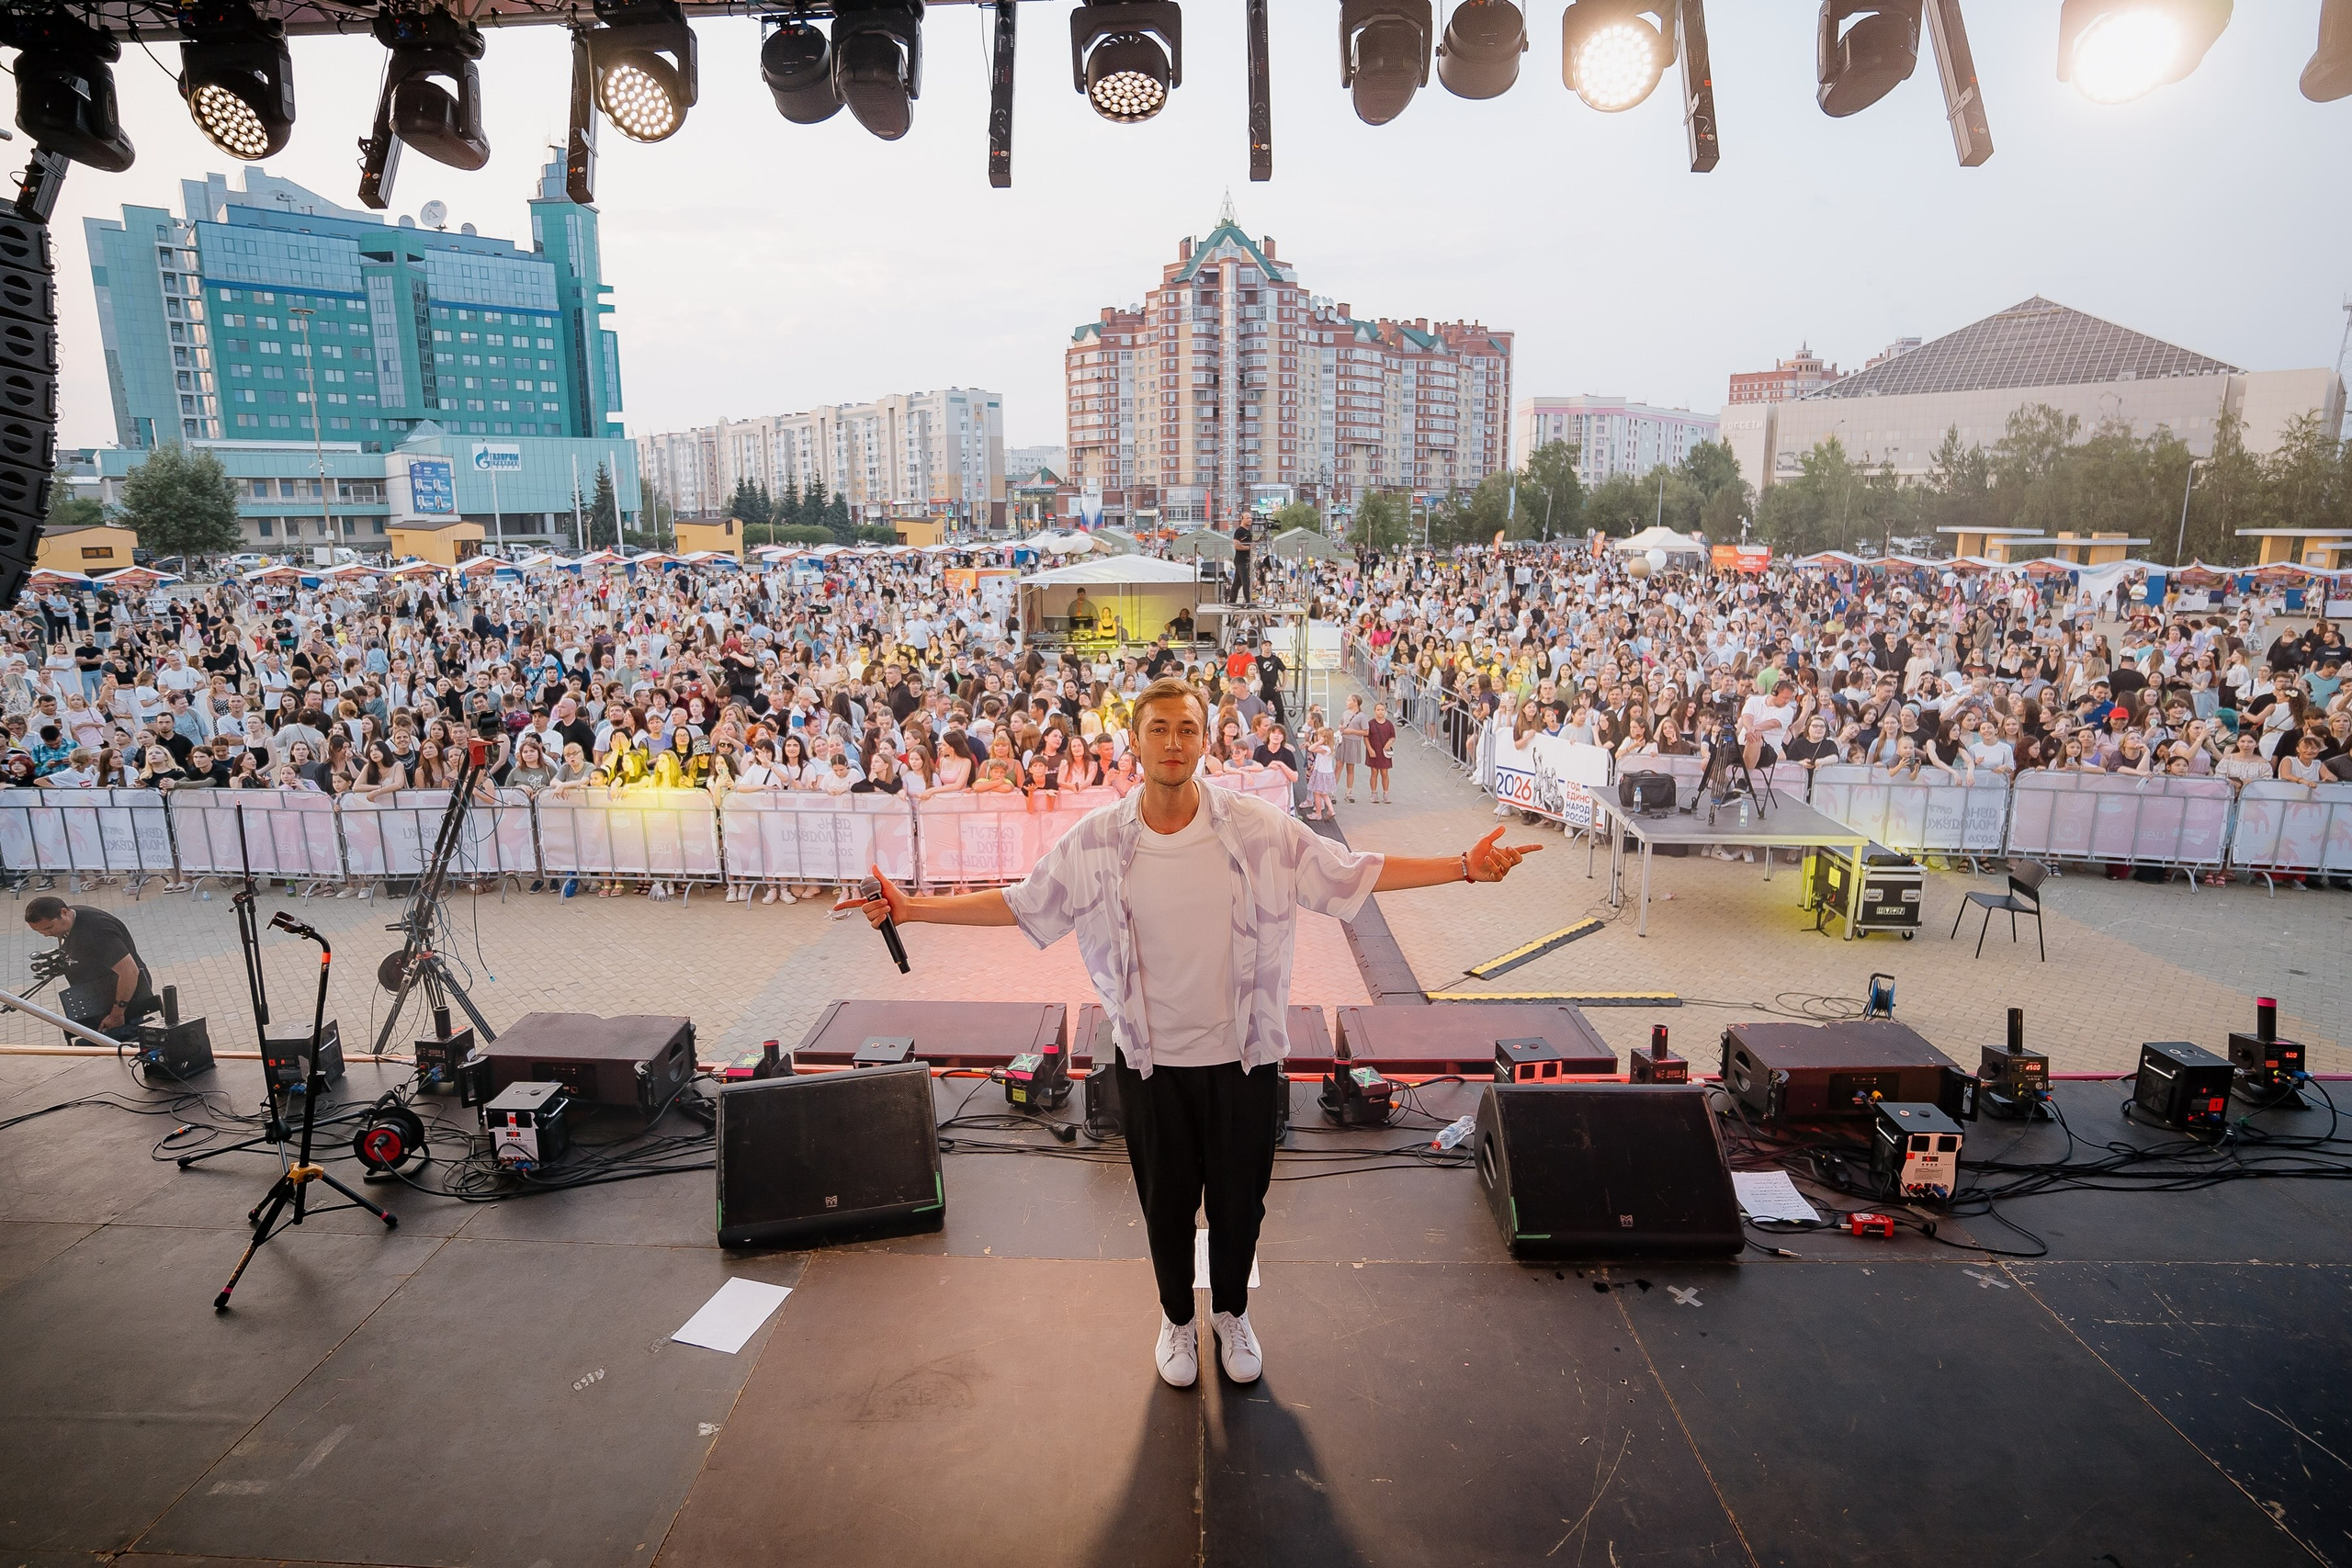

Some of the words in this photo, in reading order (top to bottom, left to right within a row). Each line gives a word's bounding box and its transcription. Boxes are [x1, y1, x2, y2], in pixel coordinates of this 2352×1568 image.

[1496, 772, 1532, 801] 2026
[1566, 781, 1580, 792] ГОД
[1566, 792, 1591, 804] ЕДИНС
[1566, 802, 1600, 817] НАРОДВ
[1566, 812, 1589, 825] РОССИ
